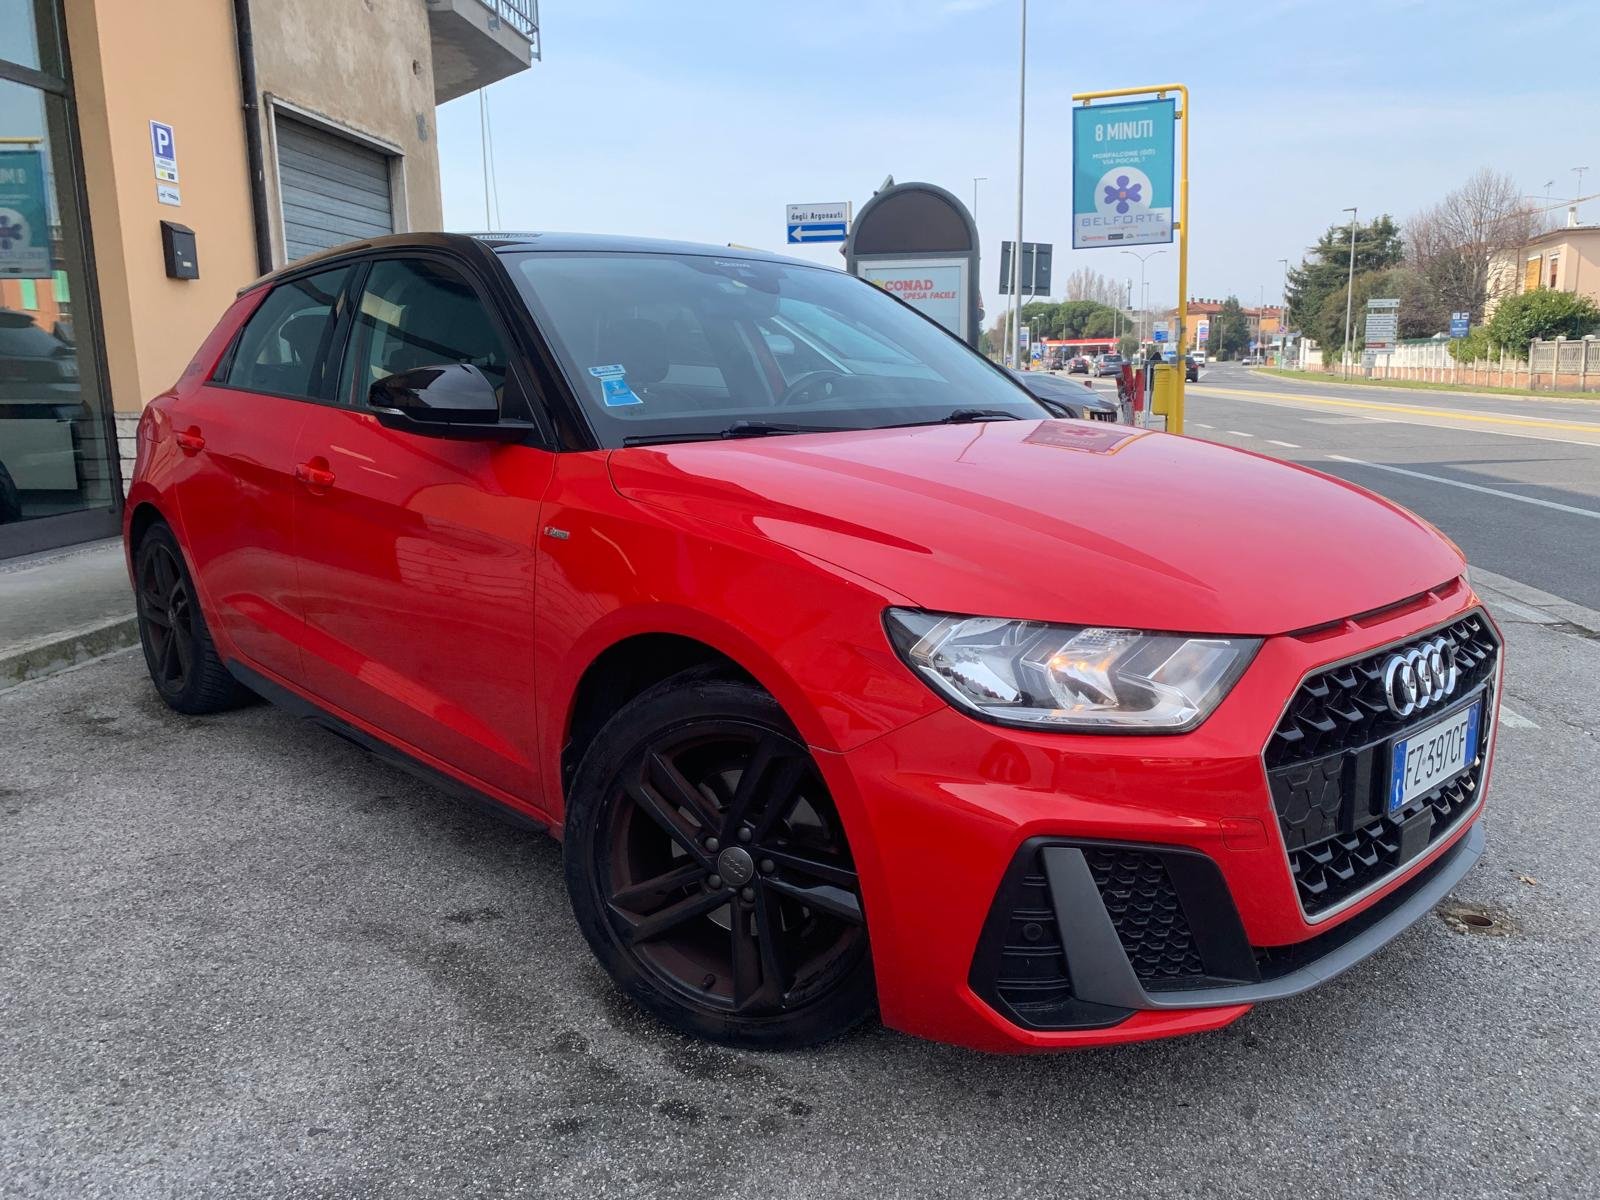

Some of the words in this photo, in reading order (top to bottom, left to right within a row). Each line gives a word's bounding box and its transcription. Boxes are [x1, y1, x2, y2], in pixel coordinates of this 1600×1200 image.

[1095, 124, 1104, 142] 8
[1107, 120, 1153, 141] MINUTI
[156, 128, 169, 153] P
[791, 212, 808, 221] degli
[810, 211, 843, 221] Argonauti
[1081, 212, 1165, 227] BELFORTE
[884, 279, 934, 292] CONAD
[903, 291, 928, 300] SPESA
[930, 291, 957, 300] FACILE
